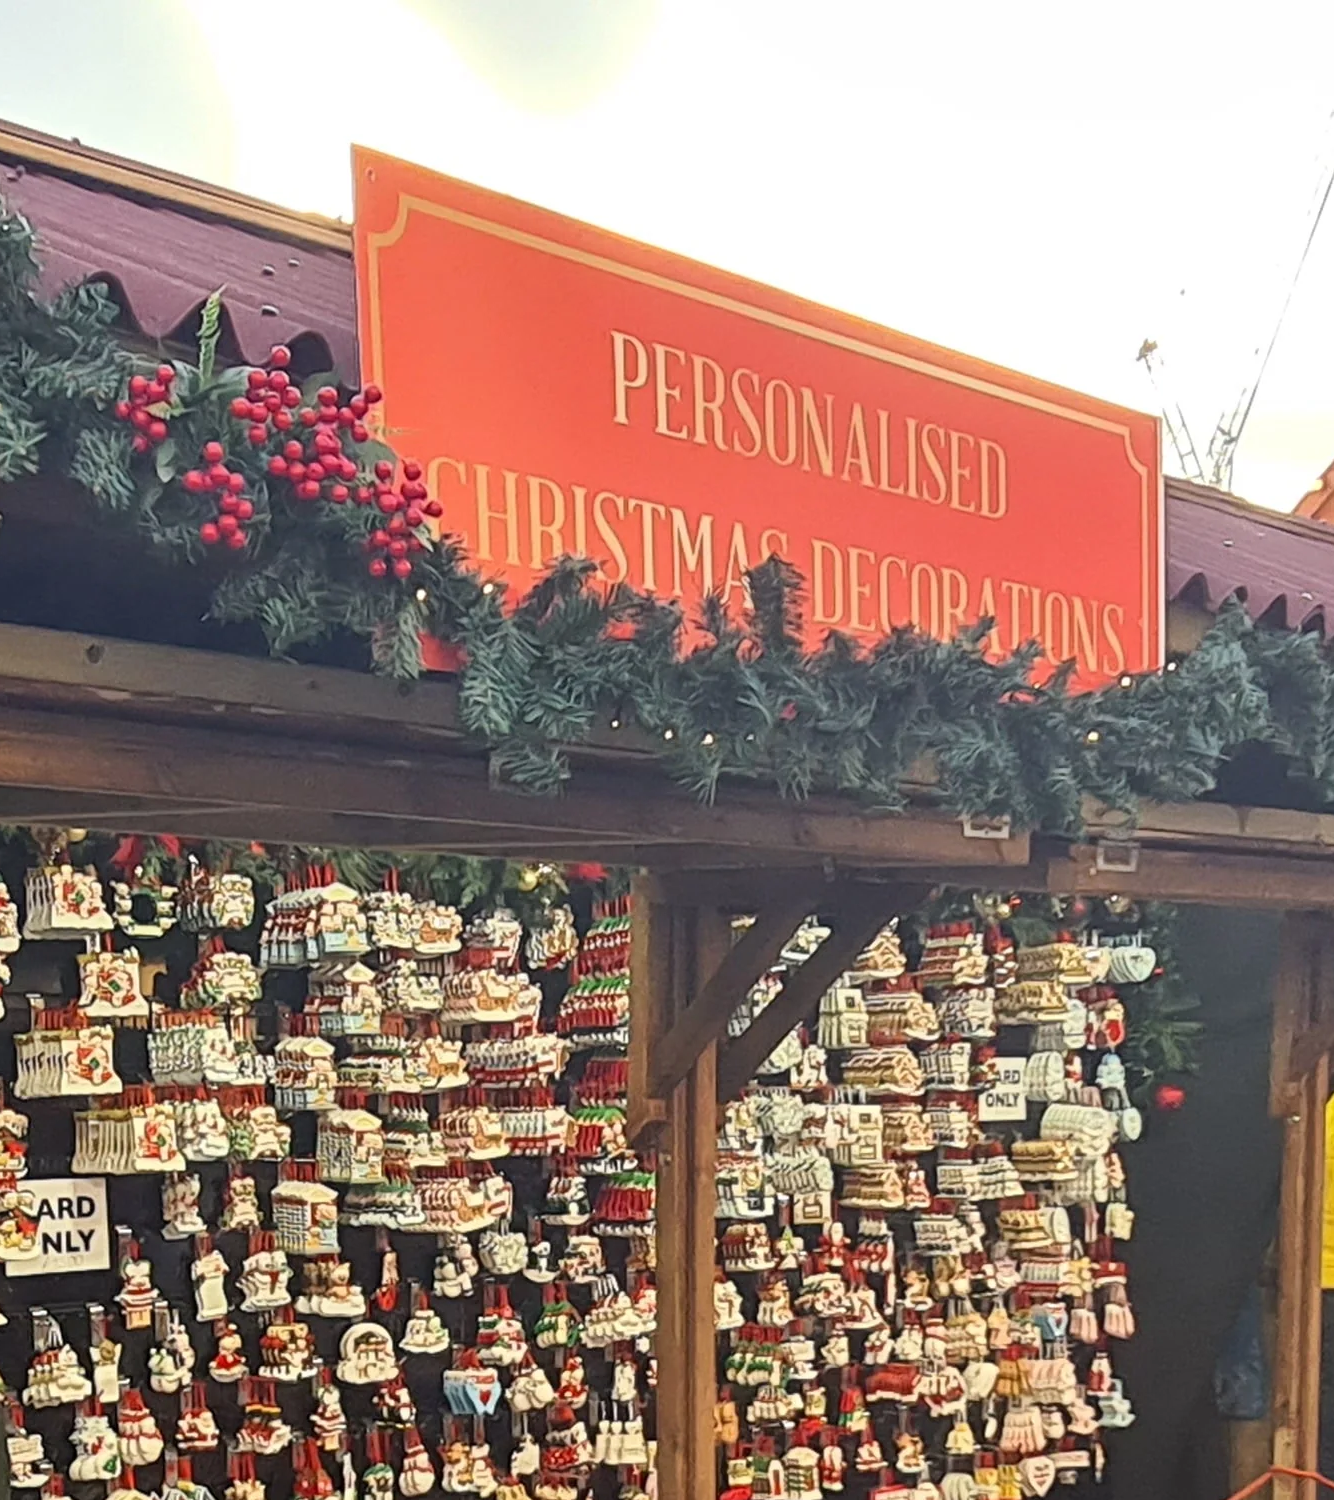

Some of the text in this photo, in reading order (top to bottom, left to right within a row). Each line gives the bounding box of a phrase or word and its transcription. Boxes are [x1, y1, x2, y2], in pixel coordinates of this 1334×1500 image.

[610, 329, 1008, 519] PERSONALISED
[811, 538, 1125, 677] DECORATIONS
[986, 1092, 1020, 1108] ONLY
[37, 1195, 96, 1220] ARD
[41, 1229, 95, 1255] NLY
